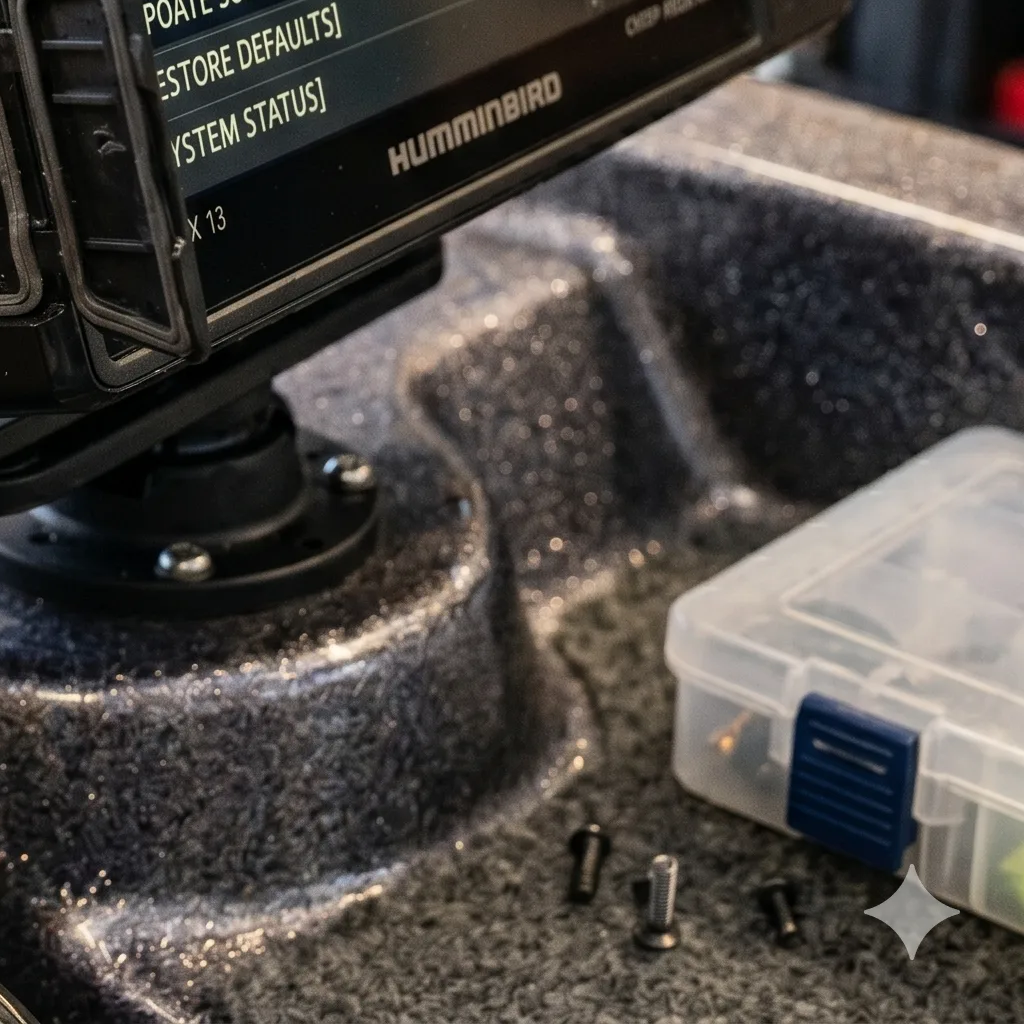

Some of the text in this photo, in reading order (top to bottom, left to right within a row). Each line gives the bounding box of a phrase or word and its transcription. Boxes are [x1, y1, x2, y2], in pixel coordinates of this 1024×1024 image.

[156, 2, 342, 101] ESTORE DEFAULTS]
[170, 76, 327, 167] YSTEM STATUS]
[387, 72, 563, 176] HUMMINBIRD
[206, 205, 226, 234] 13
